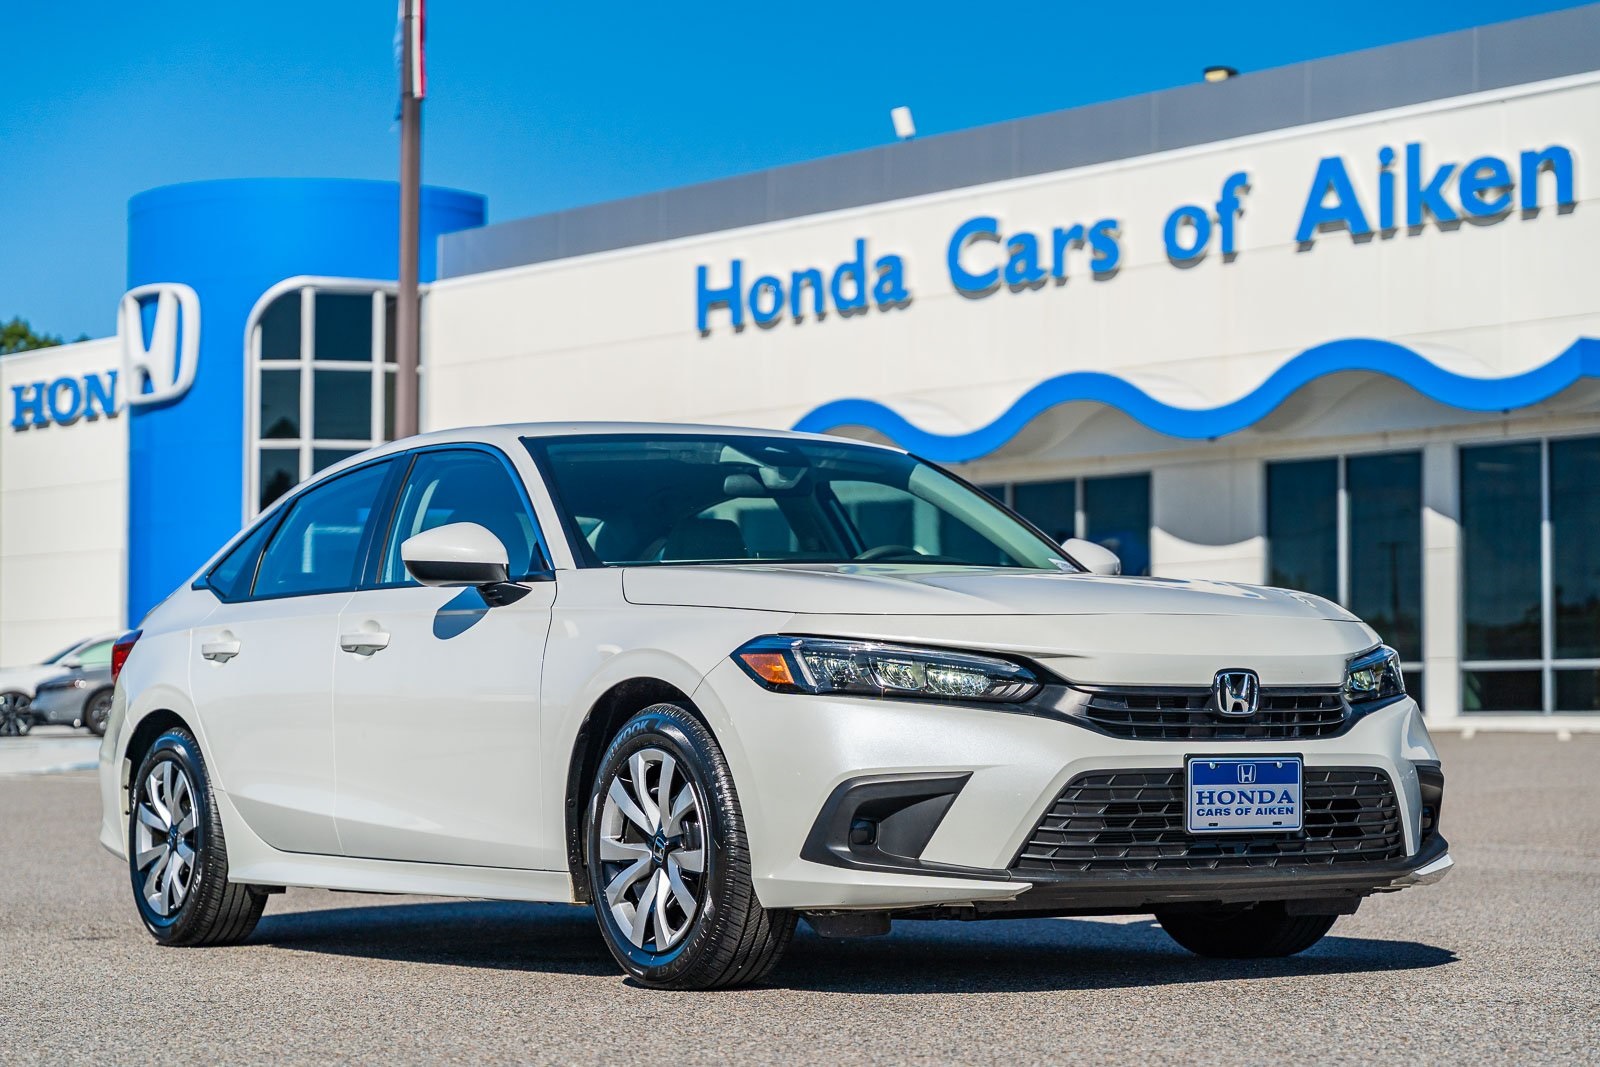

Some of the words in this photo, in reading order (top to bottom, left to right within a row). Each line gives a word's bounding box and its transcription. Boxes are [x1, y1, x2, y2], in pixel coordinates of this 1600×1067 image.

[696, 238, 910, 334] Honda
[946, 216, 1120, 293] Cars
[1163, 171, 1249, 261] of
[1295, 142, 1574, 244] Aiken
[1196, 789, 1295, 806] HONDA
[1196, 807, 1231, 817] CARS
[1235, 807, 1252, 816] OF
[1255, 806, 1294, 816] AIKEN
